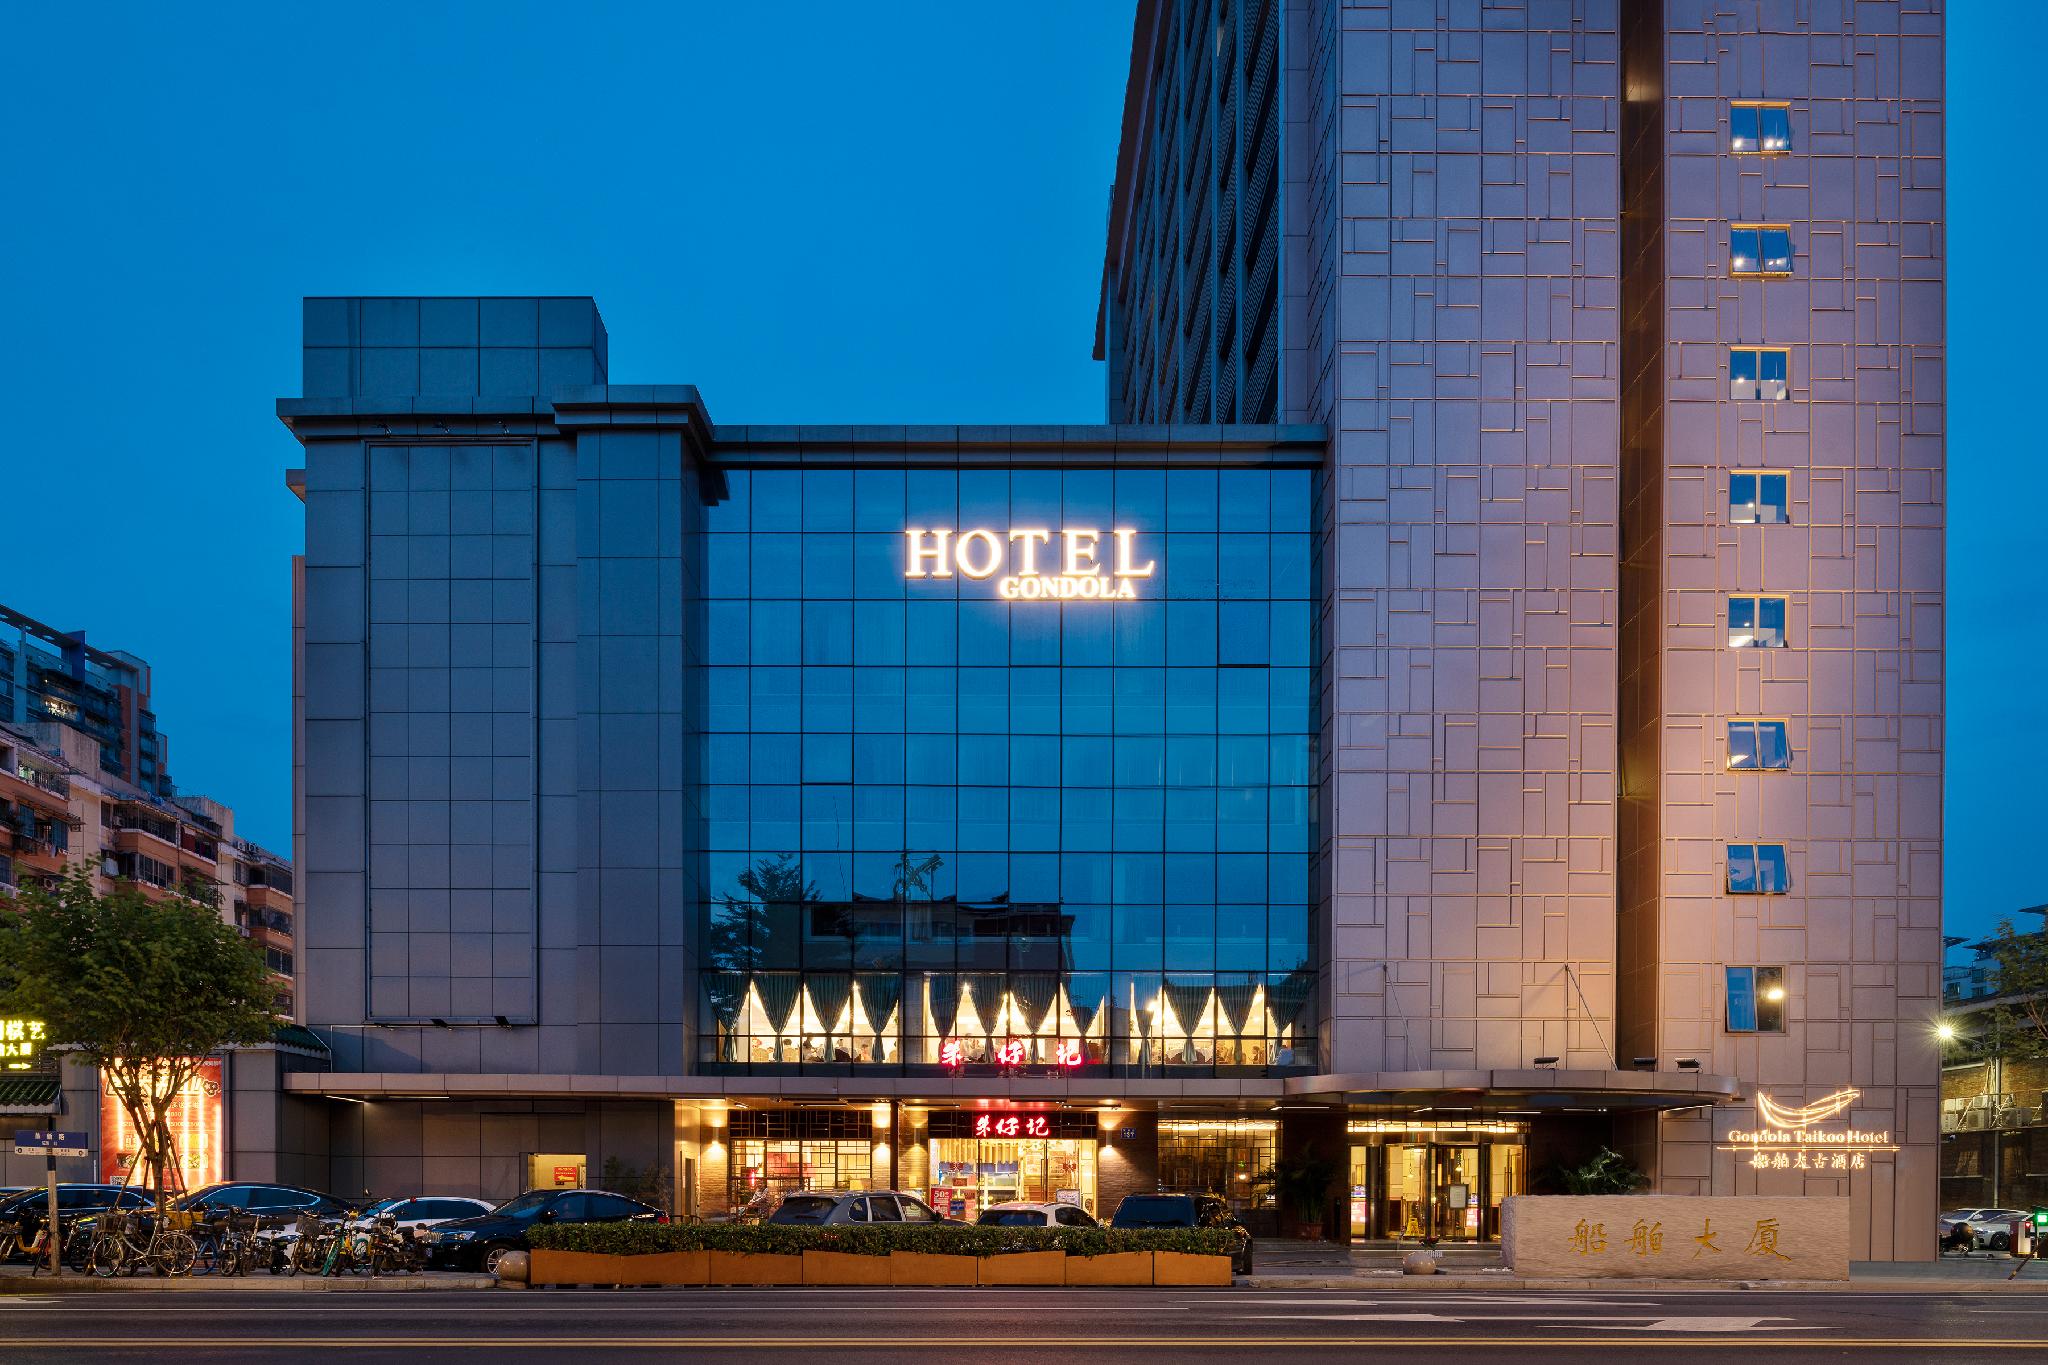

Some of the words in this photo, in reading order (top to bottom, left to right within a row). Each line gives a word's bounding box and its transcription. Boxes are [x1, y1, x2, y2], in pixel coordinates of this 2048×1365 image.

[904, 529, 1155, 579] HOTEL
[999, 576, 1137, 599] GONDOLA
[1728, 1129, 1791, 1143] Gondola
[1793, 1129, 1845, 1143] Taikoo
[1847, 1130, 1889, 1143] Hotel
[1749, 1151, 1865, 1169] 船舶太古酒店
[1567, 1216, 1793, 1261] 船舶大厦
